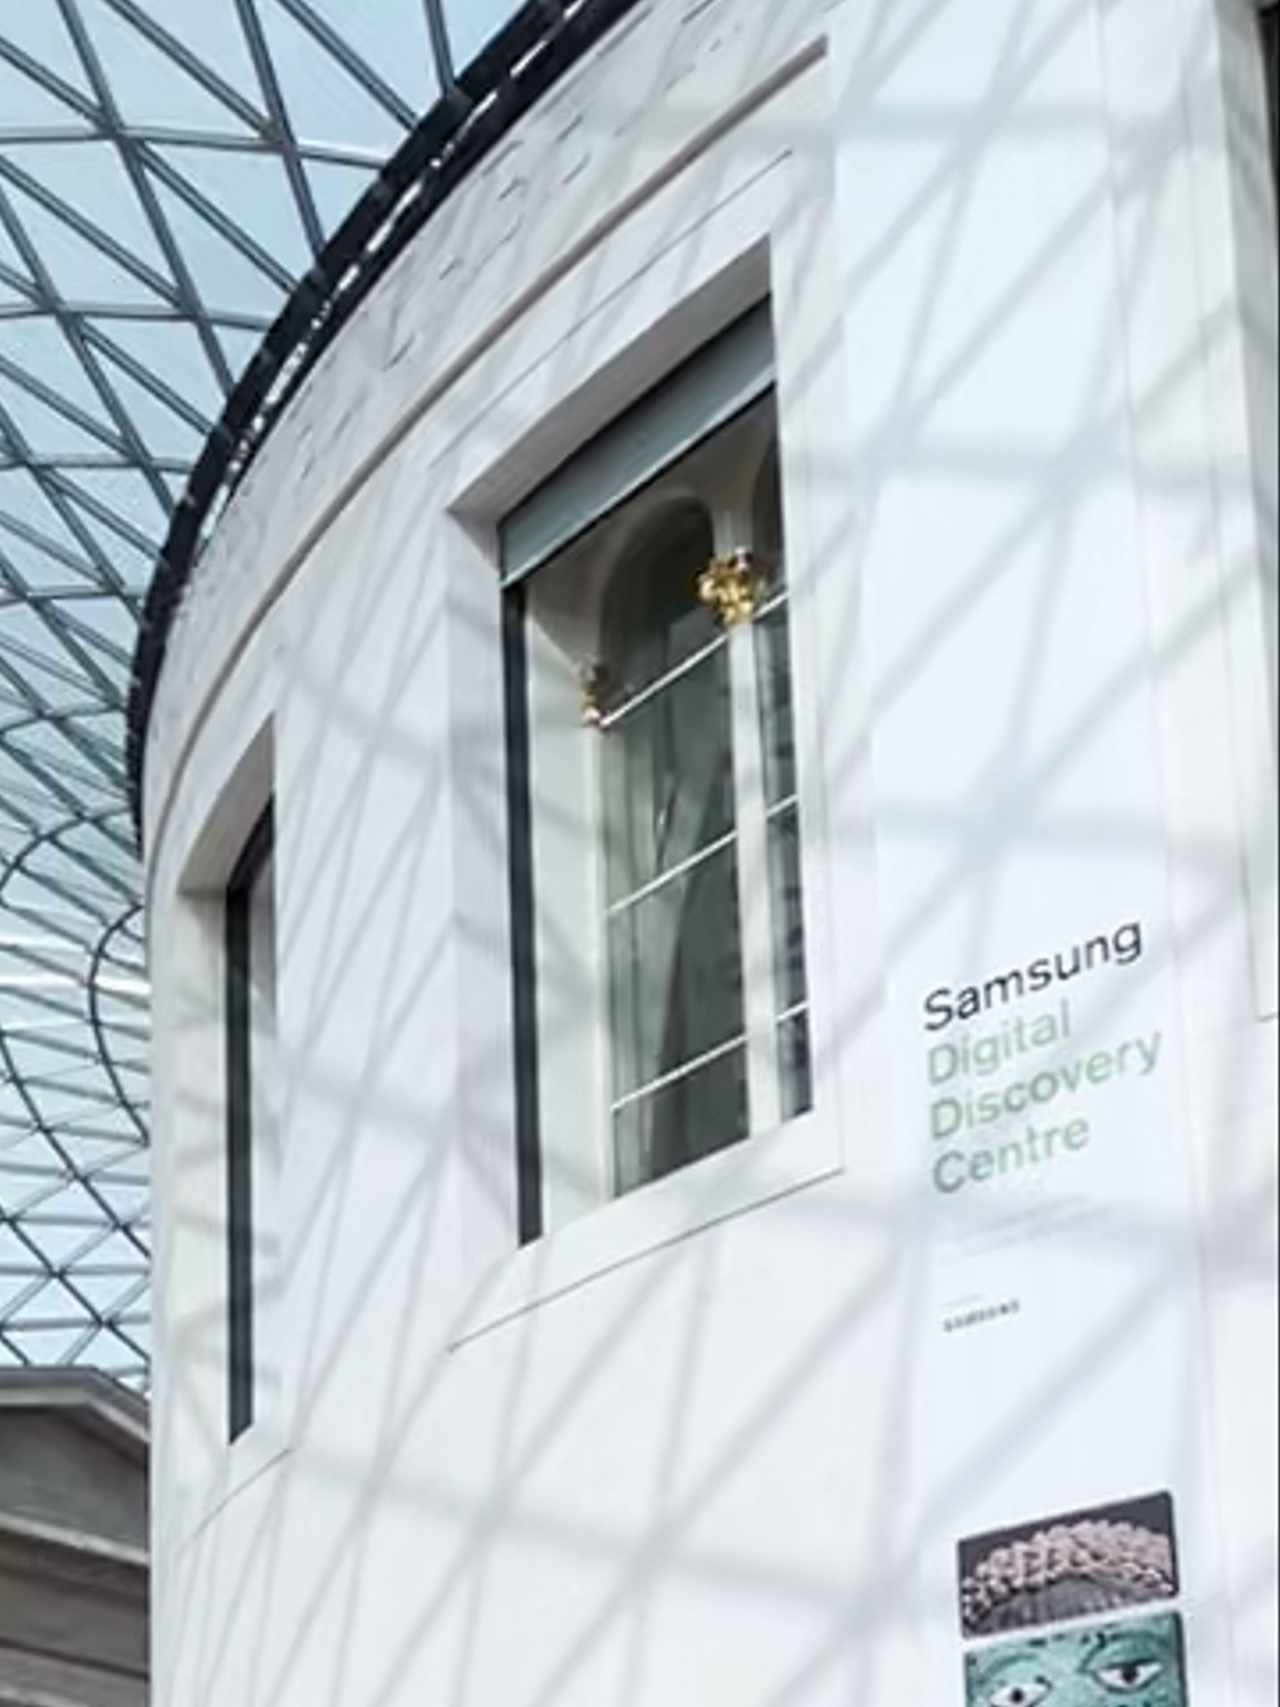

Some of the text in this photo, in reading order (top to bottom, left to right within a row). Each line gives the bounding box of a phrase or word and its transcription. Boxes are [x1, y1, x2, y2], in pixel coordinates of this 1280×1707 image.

[924, 921, 1142, 1031] Samsung
[927, 997, 1071, 1086] Digital
[929, 1031, 1162, 1139] Discovery
[932, 1118, 1090, 1193] Centre
